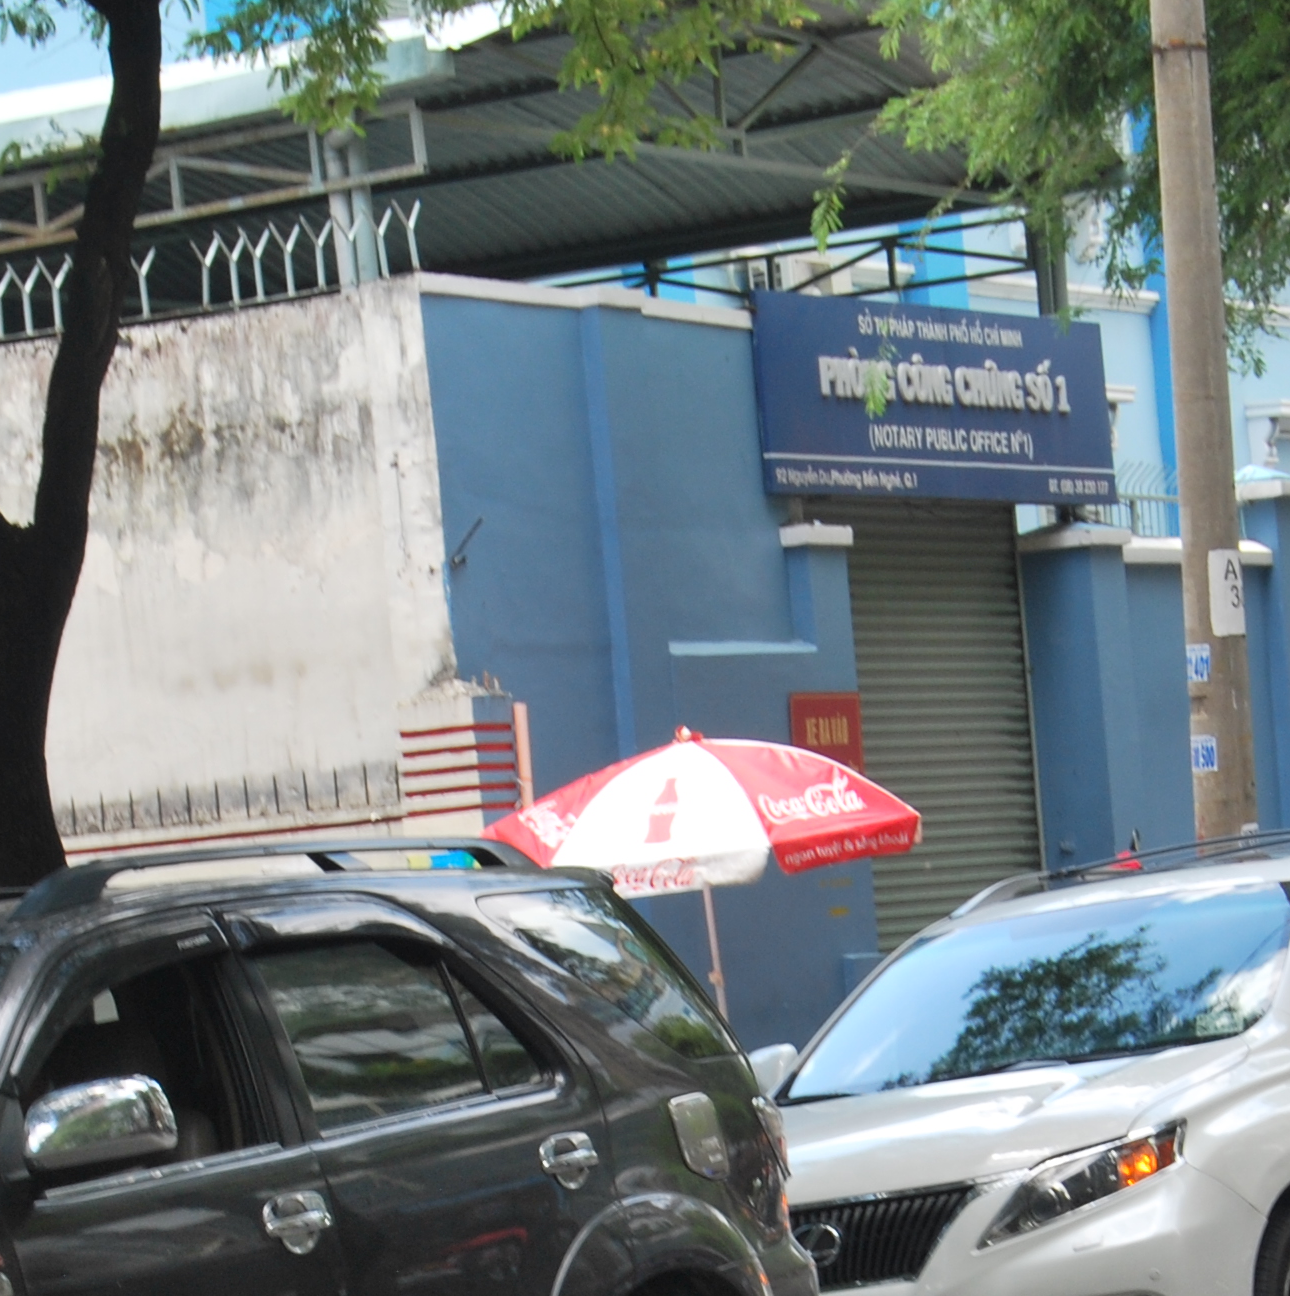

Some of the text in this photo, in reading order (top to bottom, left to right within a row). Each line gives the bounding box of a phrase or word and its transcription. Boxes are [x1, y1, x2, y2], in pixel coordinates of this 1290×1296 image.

[897, 353, 955, 406] CÔNG
[954, 359, 1026, 411] CHỨNG
[1025, 359, 1054, 413] SỐ
[1055, 375, 1071, 414] 1
[869, 423, 924, 452] (NOTARY
[925, 426, 968, 452] PUBLIC
[969, 429, 1010, 454] OFFICE
